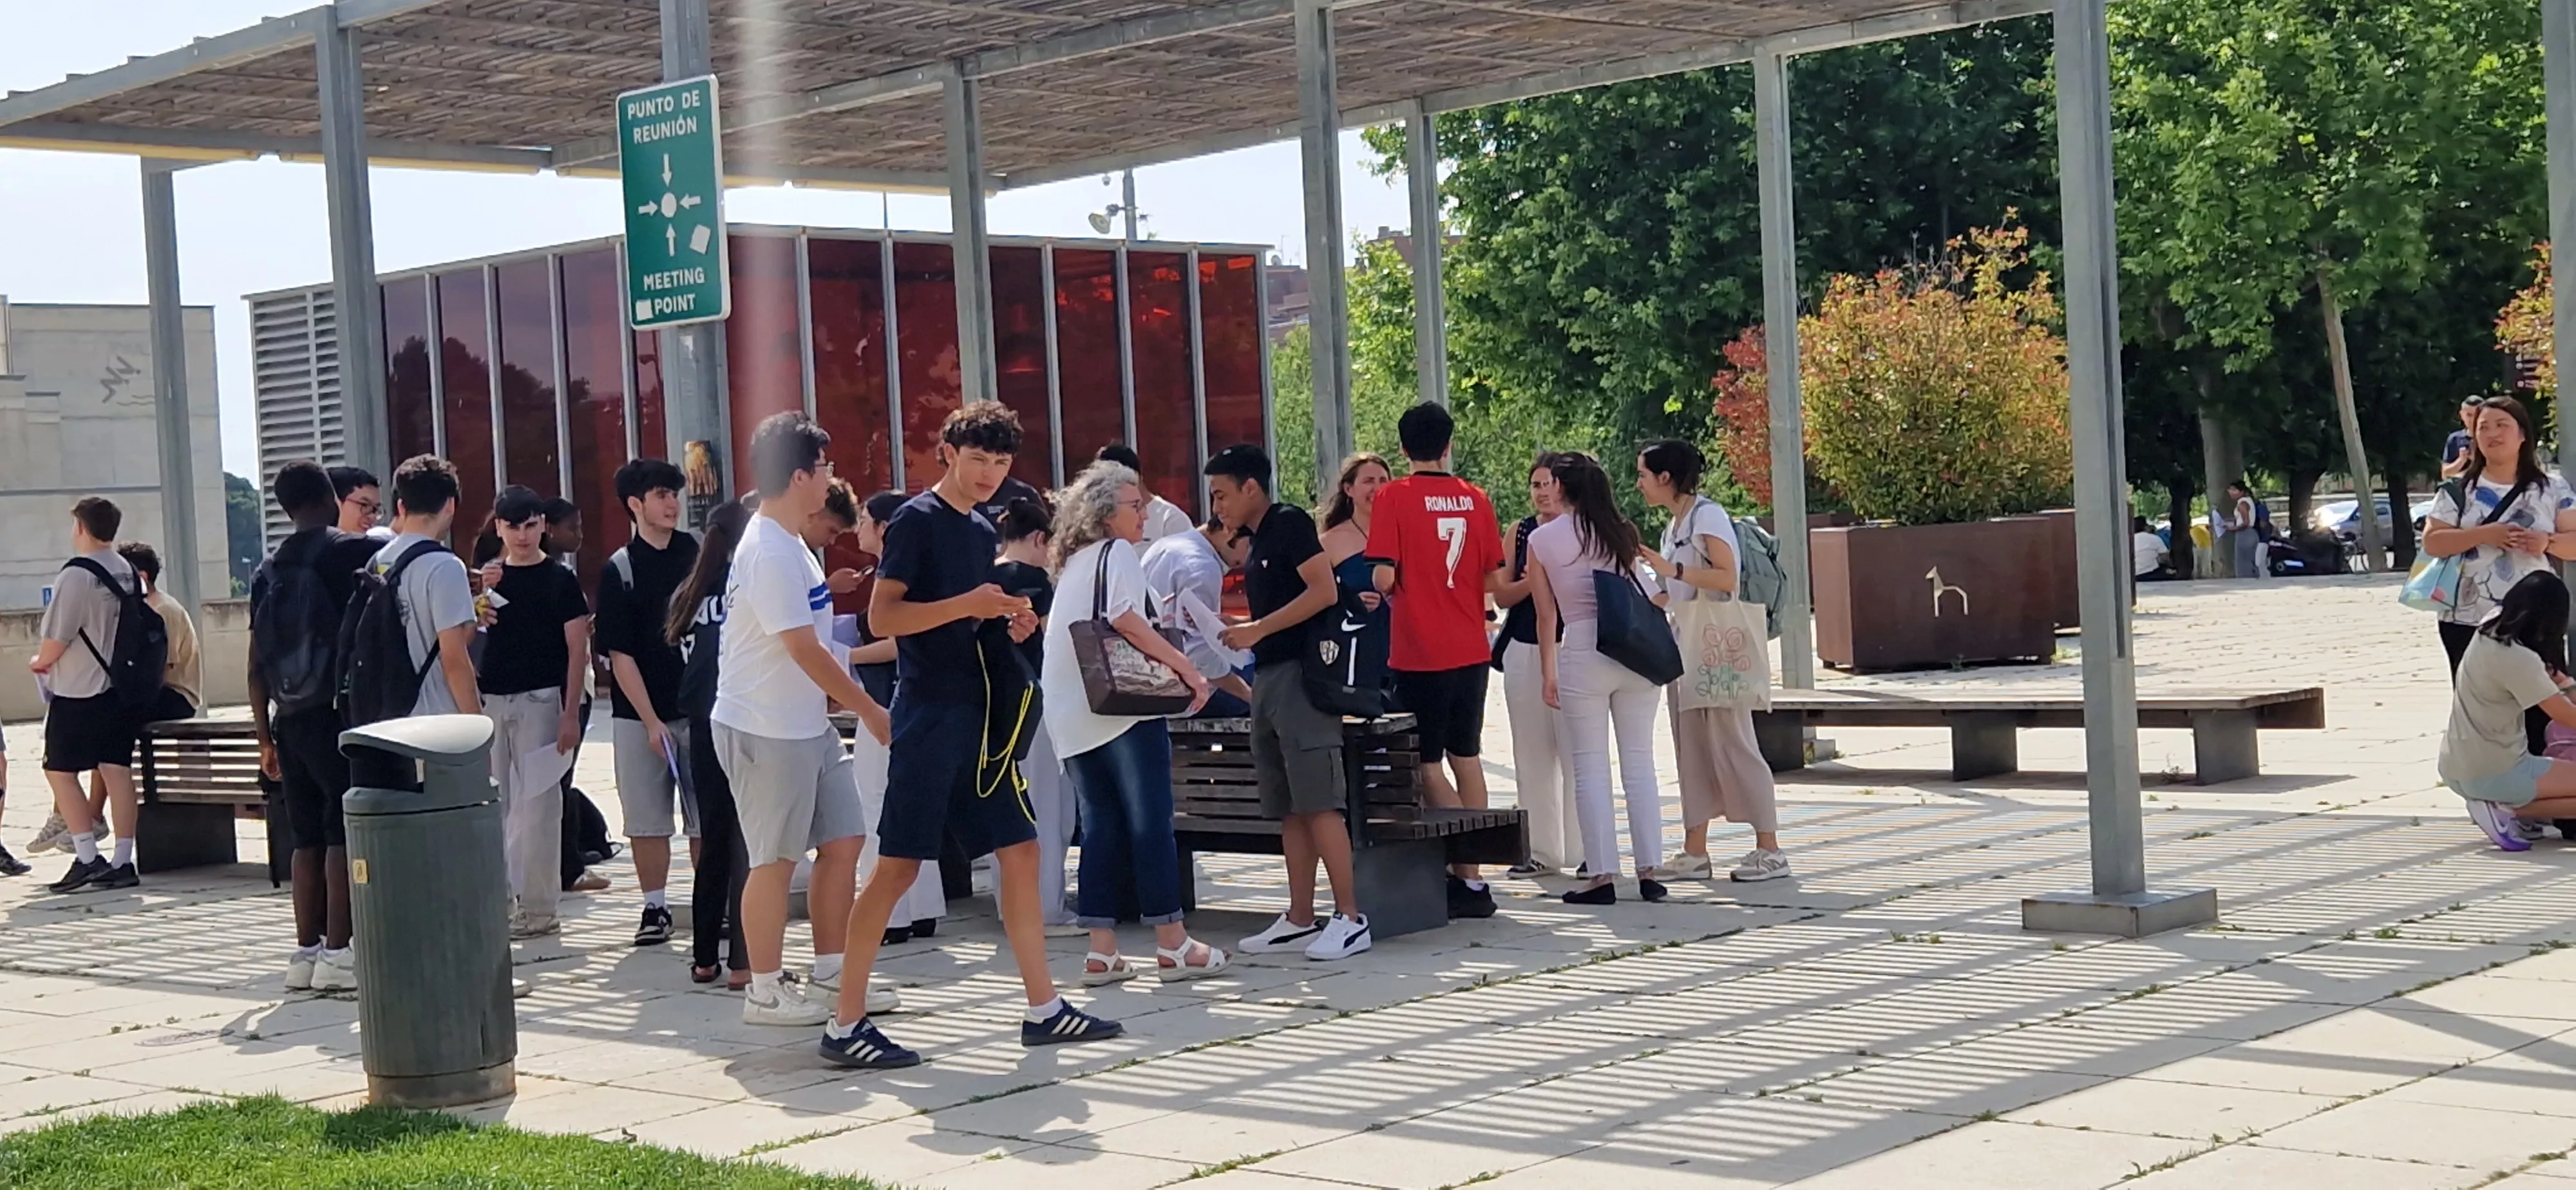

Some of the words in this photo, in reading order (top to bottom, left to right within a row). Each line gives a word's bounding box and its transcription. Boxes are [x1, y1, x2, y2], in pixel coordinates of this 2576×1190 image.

[627, 95, 674, 120] PUNTO
[682, 90, 701, 108] DE
[634, 115, 697, 144] REUNIÓN
[643, 267, 705, 290] MEETING
[654, 294, 696, 315] POINT
[1425, 496, 1474, 511] RONALDO
[1437, 517, 1467, 589] 7
